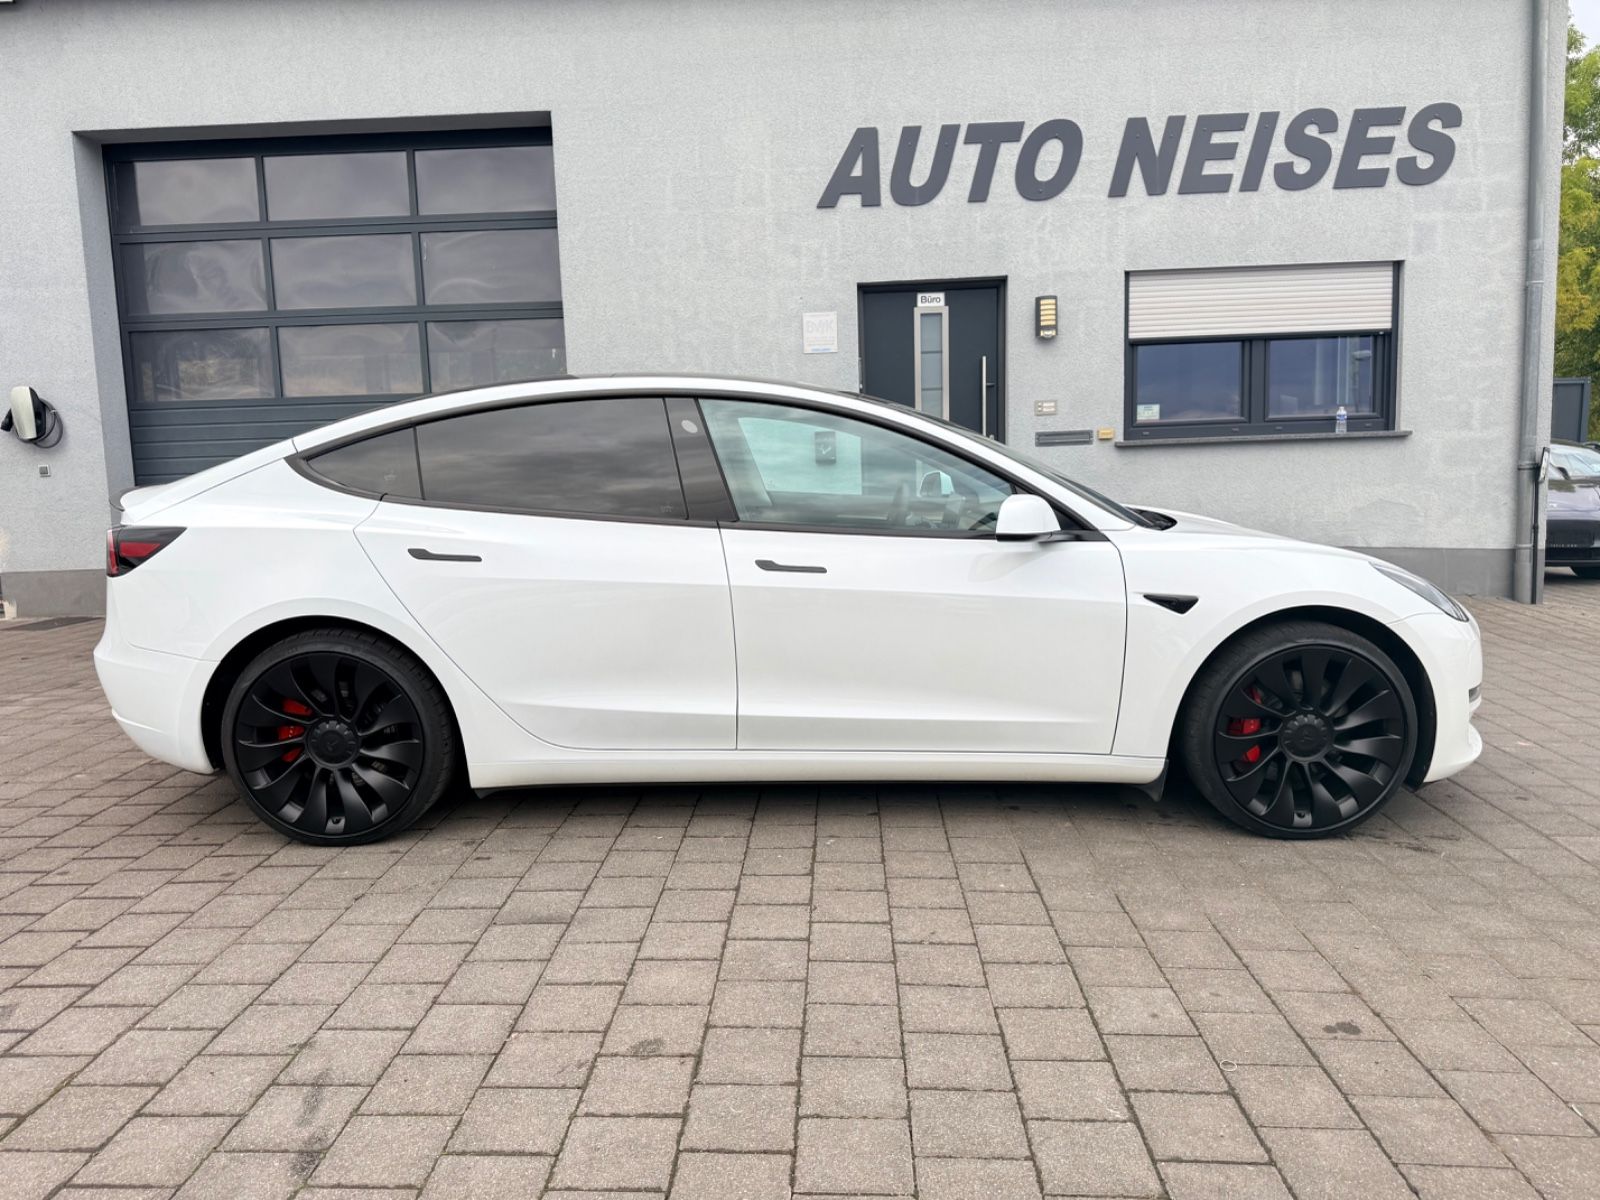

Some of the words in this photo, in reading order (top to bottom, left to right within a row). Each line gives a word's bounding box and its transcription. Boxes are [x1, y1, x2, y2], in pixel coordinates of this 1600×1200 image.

[816, 118, 1083, 209] AUTO
[1107, 102, 1463, 199] NEISES
[920, 295, 941, 304] Büro
